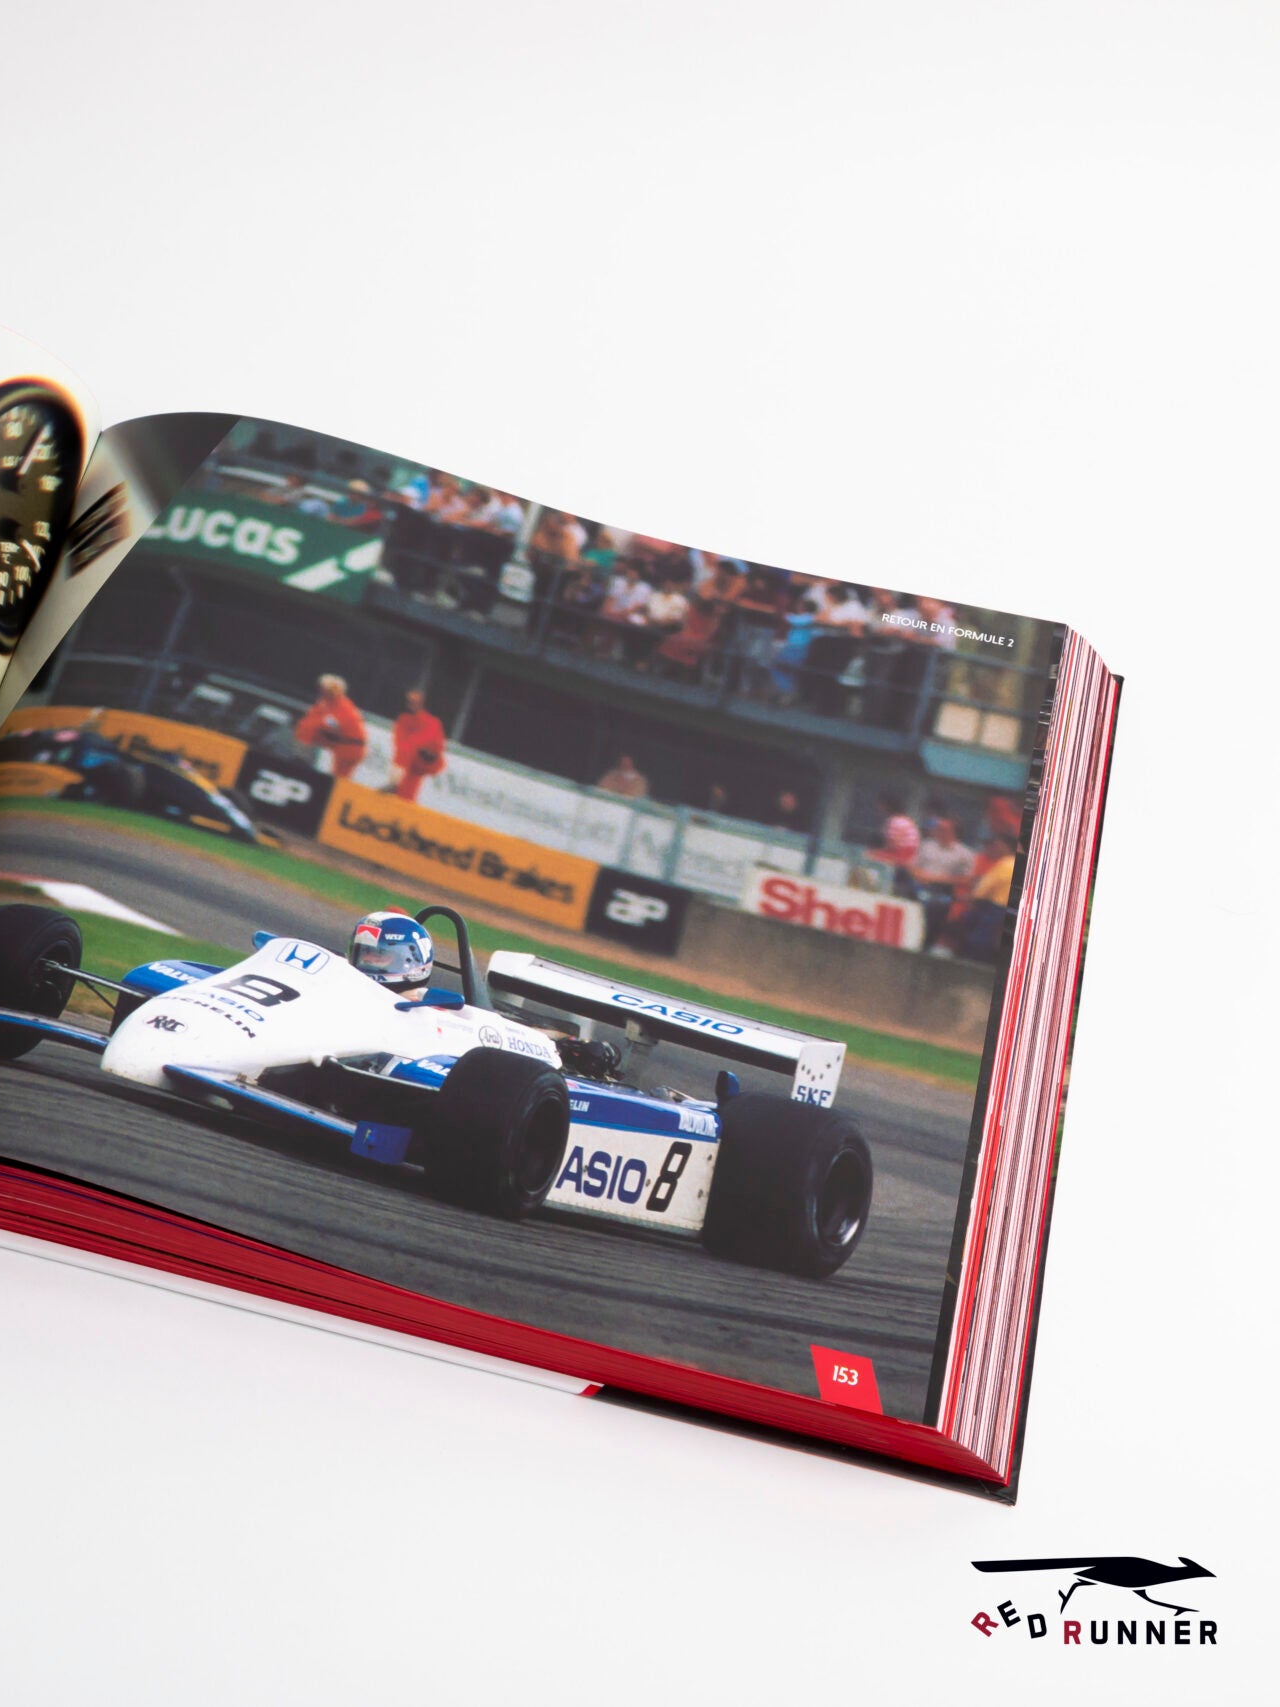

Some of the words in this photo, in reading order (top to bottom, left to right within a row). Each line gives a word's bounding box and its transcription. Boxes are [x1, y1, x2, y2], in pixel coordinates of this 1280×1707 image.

[881, 614, 927, 630] RETOUR
[930, 623, 946, 633] EN
[948, 627, 1005, 645] FORMULE
[1007, 639, 1014, 647] 2
[477, 850, 575, 904] Brakes
[759, 876, 904, 947] Shell
[612, 993, 744, 1035] CASIO
[506, 1037, 551, 1057] HONDA
[794, 1085, 832, 1107] SKF
[555, 1145, 647, 1204] ASIO
[646, 1141, 692, 1212] 8
[832, 1364, 859, 1386] 153
